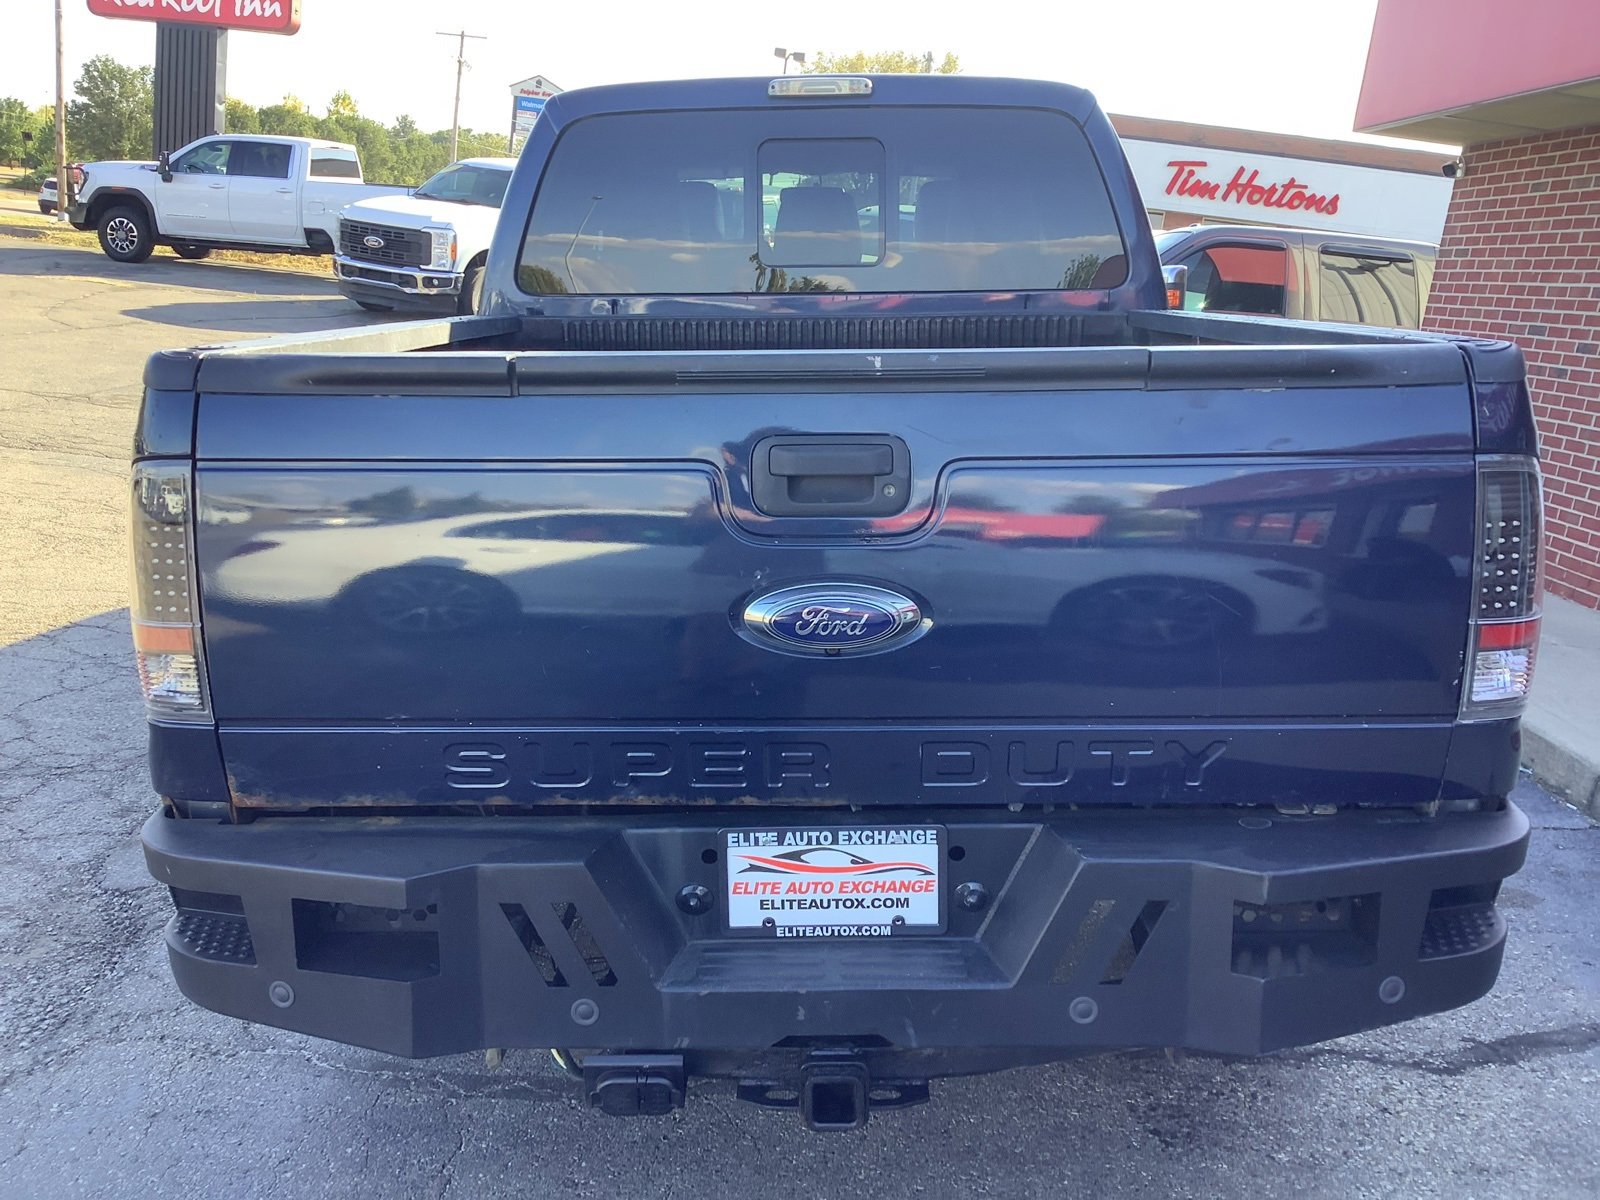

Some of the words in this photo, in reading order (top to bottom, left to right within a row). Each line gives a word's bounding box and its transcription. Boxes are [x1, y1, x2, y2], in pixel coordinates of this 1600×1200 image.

[234, 0, 283, 18] Inn
[521, 100, 545, 109] Walmar
[1165, 160, 1221, 200] Tim
[1222, 166, 1341, 215] Hortons
[795, 605, 869, 636] Ford
[442, 741, 832, 788] SUPER
[919, 740, 1229, 787] DUTY
[727, 832, 779, 847] ELITE
[783, 831, 833, 846] AUTO
[838, 829, 938, 845] EXCHANGE
[732, 881, 782, 895] ELITE
[785, 880, 834, 895] AUTO
[838, 879, 936, 894] EXCHANGE
[759, 897, 910, 910] ELITEAUTOX.COM
[776, 925, 892, 937] ELITEAUTOX.COM
